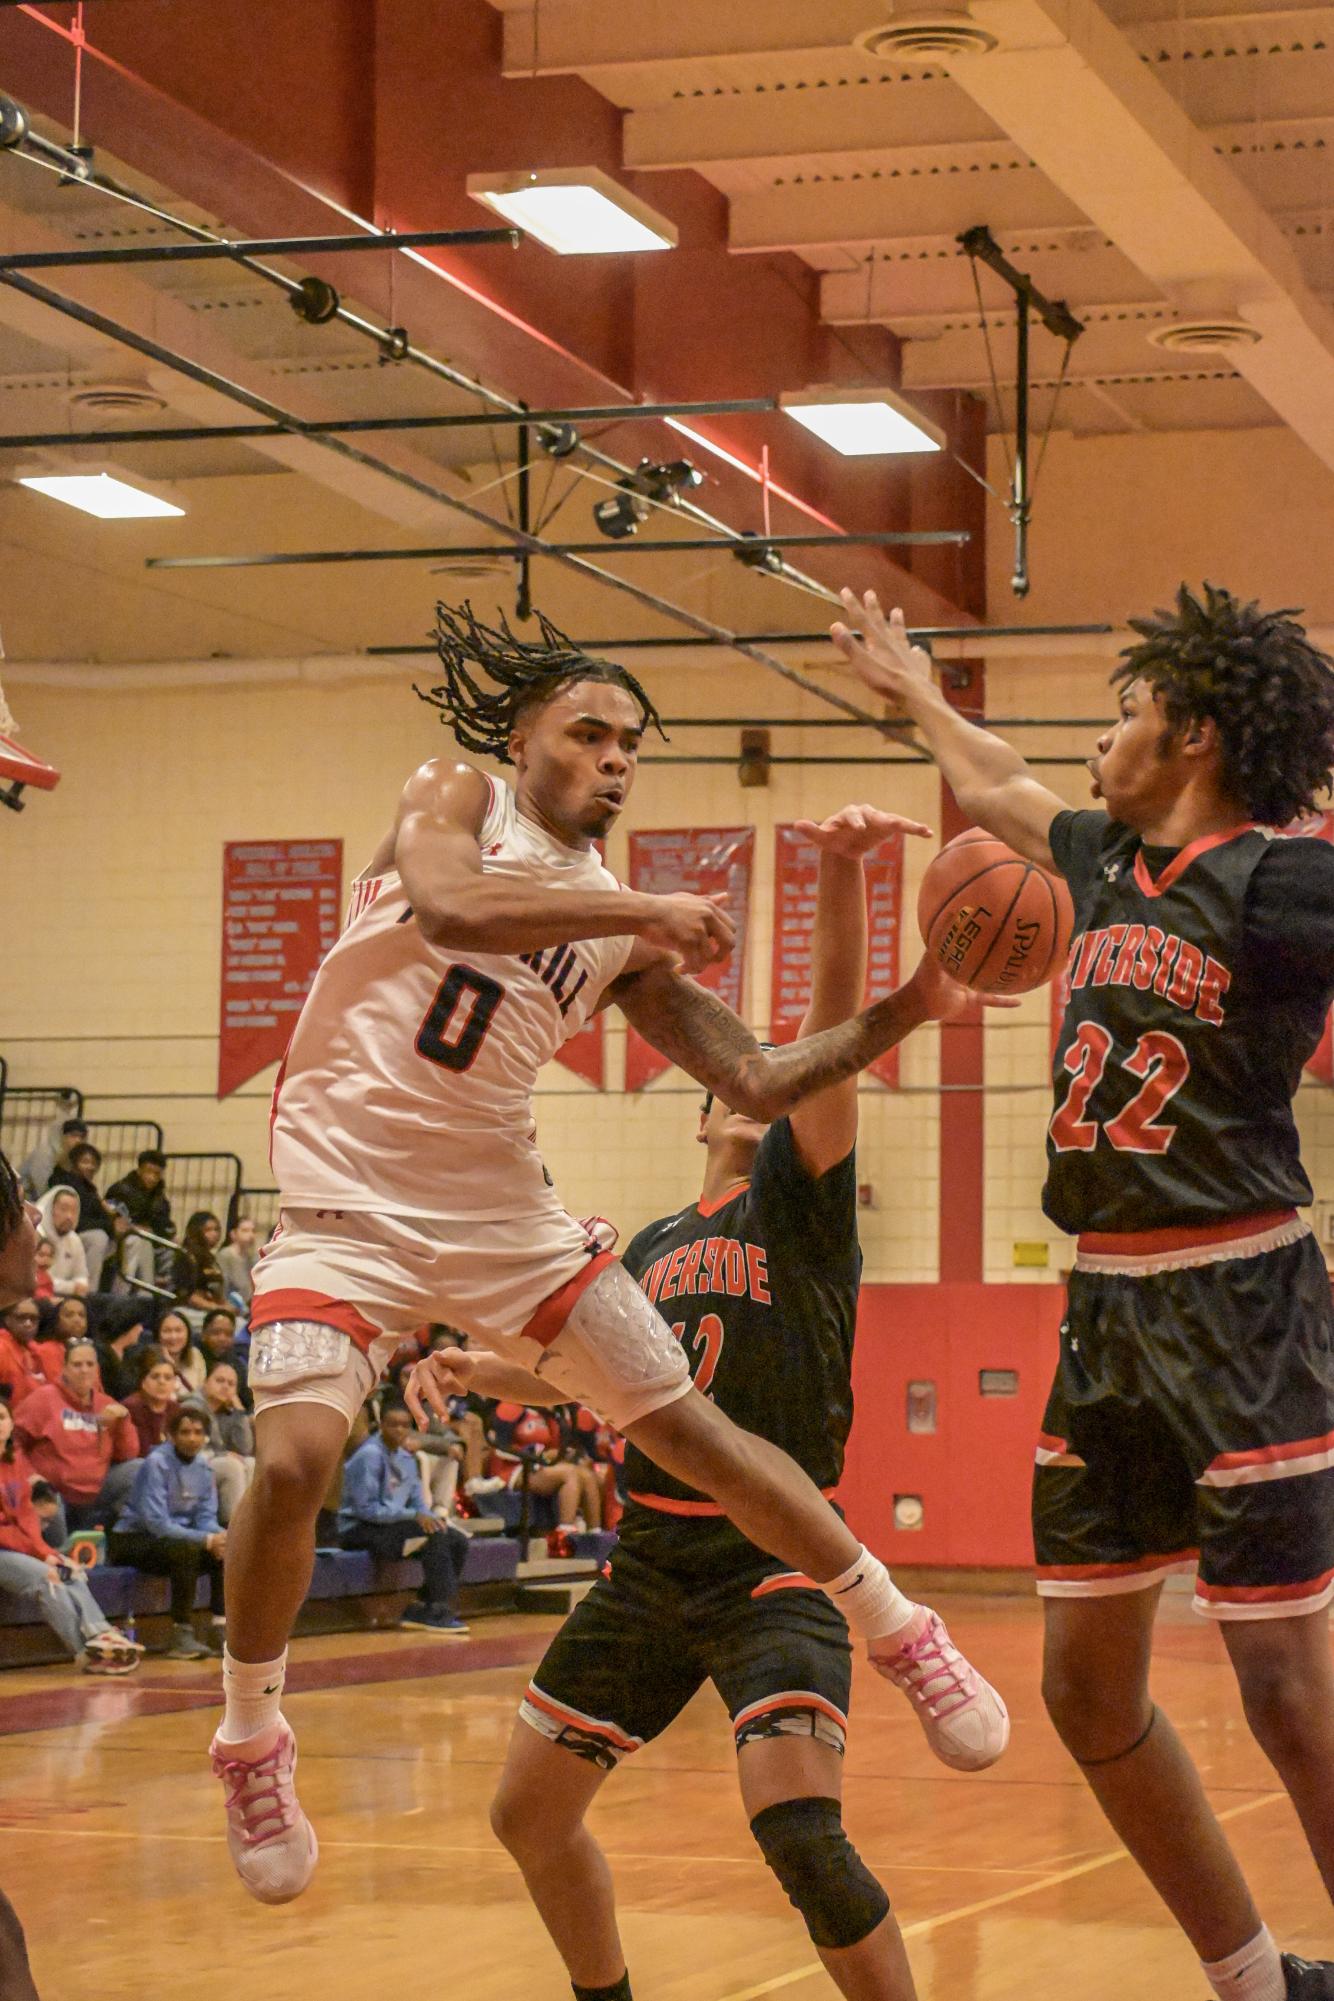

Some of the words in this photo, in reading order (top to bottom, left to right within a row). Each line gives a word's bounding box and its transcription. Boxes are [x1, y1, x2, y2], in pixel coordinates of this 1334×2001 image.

[413, 963, 506, 1074] 0
[1063, 924, 1231, 1027] IVERSIDE
[1049, 1020, 1190, 1154] 22
[638, 1236, 772, 1306] IVERSIDE
